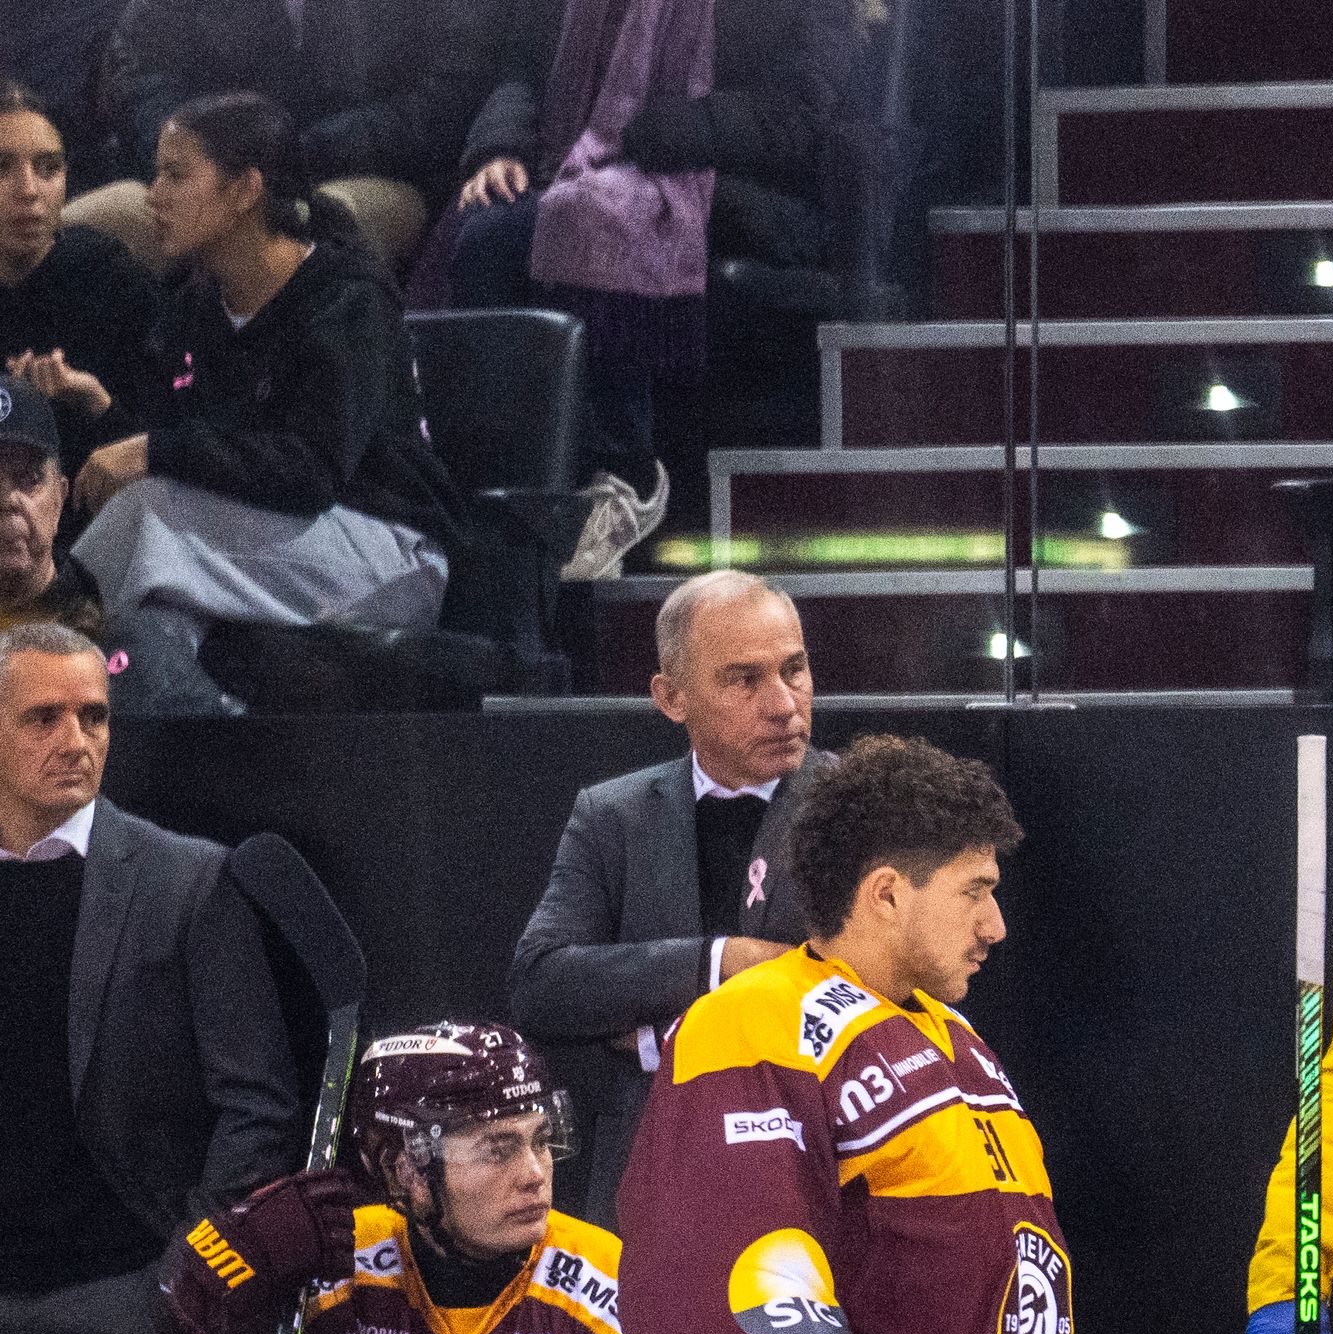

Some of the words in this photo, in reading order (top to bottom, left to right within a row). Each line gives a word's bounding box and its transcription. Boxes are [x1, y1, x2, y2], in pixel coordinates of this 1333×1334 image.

[480, 1031, 504, 1049] 27
[503, 1080, 542, 1100] TUDOR
[733, 1116, 796, 1135] SKOD
[1300, 1192, 1319, 1323] TACKS
[763, 1297, 843, 1329] SIG
